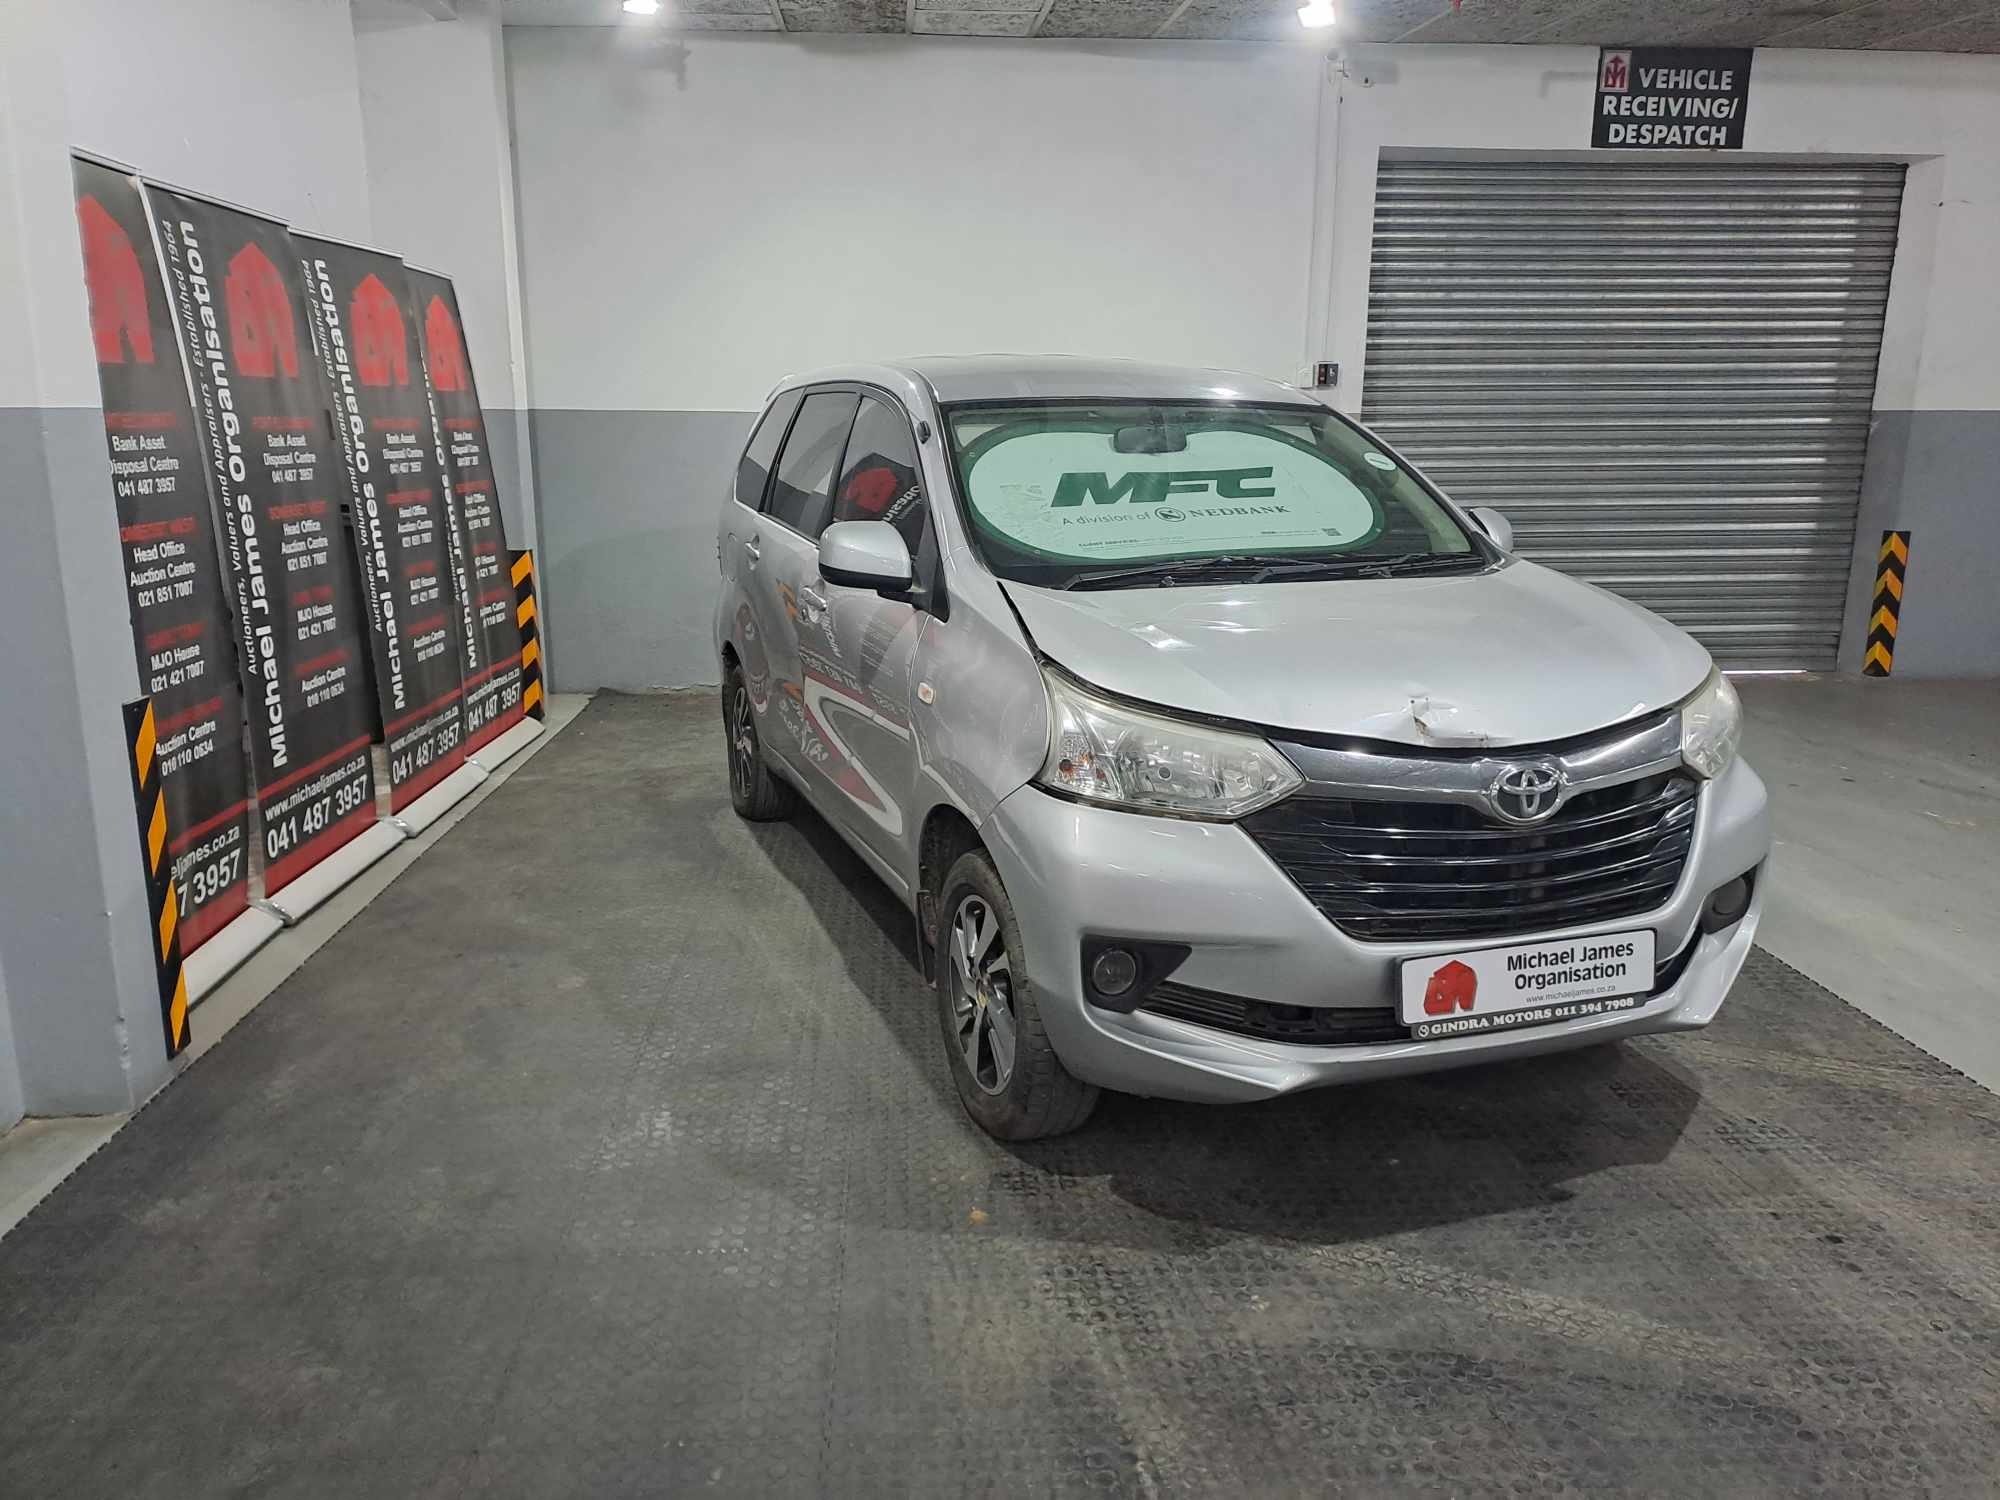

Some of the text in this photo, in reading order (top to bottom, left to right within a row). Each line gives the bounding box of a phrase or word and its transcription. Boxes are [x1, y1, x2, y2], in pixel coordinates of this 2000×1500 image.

[1639, 67, 1734, 91] VEHICLE
[1602, 95, 1739, 119] RECEIVING/
[1608, 123, 1727, 146] DESPATCH
[172, 267, 204, 367] Established
[200, 382, 224, 470] Appraisers
[118, 480, 136, 497] 041
[179, 221, 288, 768] Michael James Organisation
[217, 474, 231, 507] and
[314, 259, 405, 710] Michael James Organisation
[346, 466, 359, 493] and
[1050, 466, 1276, 507] MFC
[1062, 505, 1291, 526] A division of NEDBANK
[133, 541, 185, 563] Head Office
[226, 511, 242, 571] Valuers
[130, 561, 196, 587] Auction Centre
[138, 590, 155, 607] 021
[156, 586, 173, 602] 851
[237, 577, 257, 675] Auctioneers,
[150, 644, 200, 671] MJO House
[151, 675, 168, 693] 021
[170, 667, 185, 686] 421
[468, 681, 521, 732] 041 487 3957
[156, 720, 216, 756] Auction Centre
[392, 722, 460, 784] 041 487 3957
[162, 759, 177, 776] 010
[177, 751, 192, 769] 110
[265, 755, 366, 822] www.michaeljames.co.za
[267, 774, 367, 858] 041 487 3957
[192, 848, 240, 904] 3957
[1507, 942, 1634, 971] Michael James
[1514, 962, 1626, 990] Organisation
[1525, 985, 1616, 1004] www.michaeljames.co.za
[1431, 1016, 1489, 1035] GINDRA
[1493, 1008, 1552, 1026] MOTORS
[1555, 1006, 1577, 1017] 011
[1580, 1003, 1602, 1014] 394
